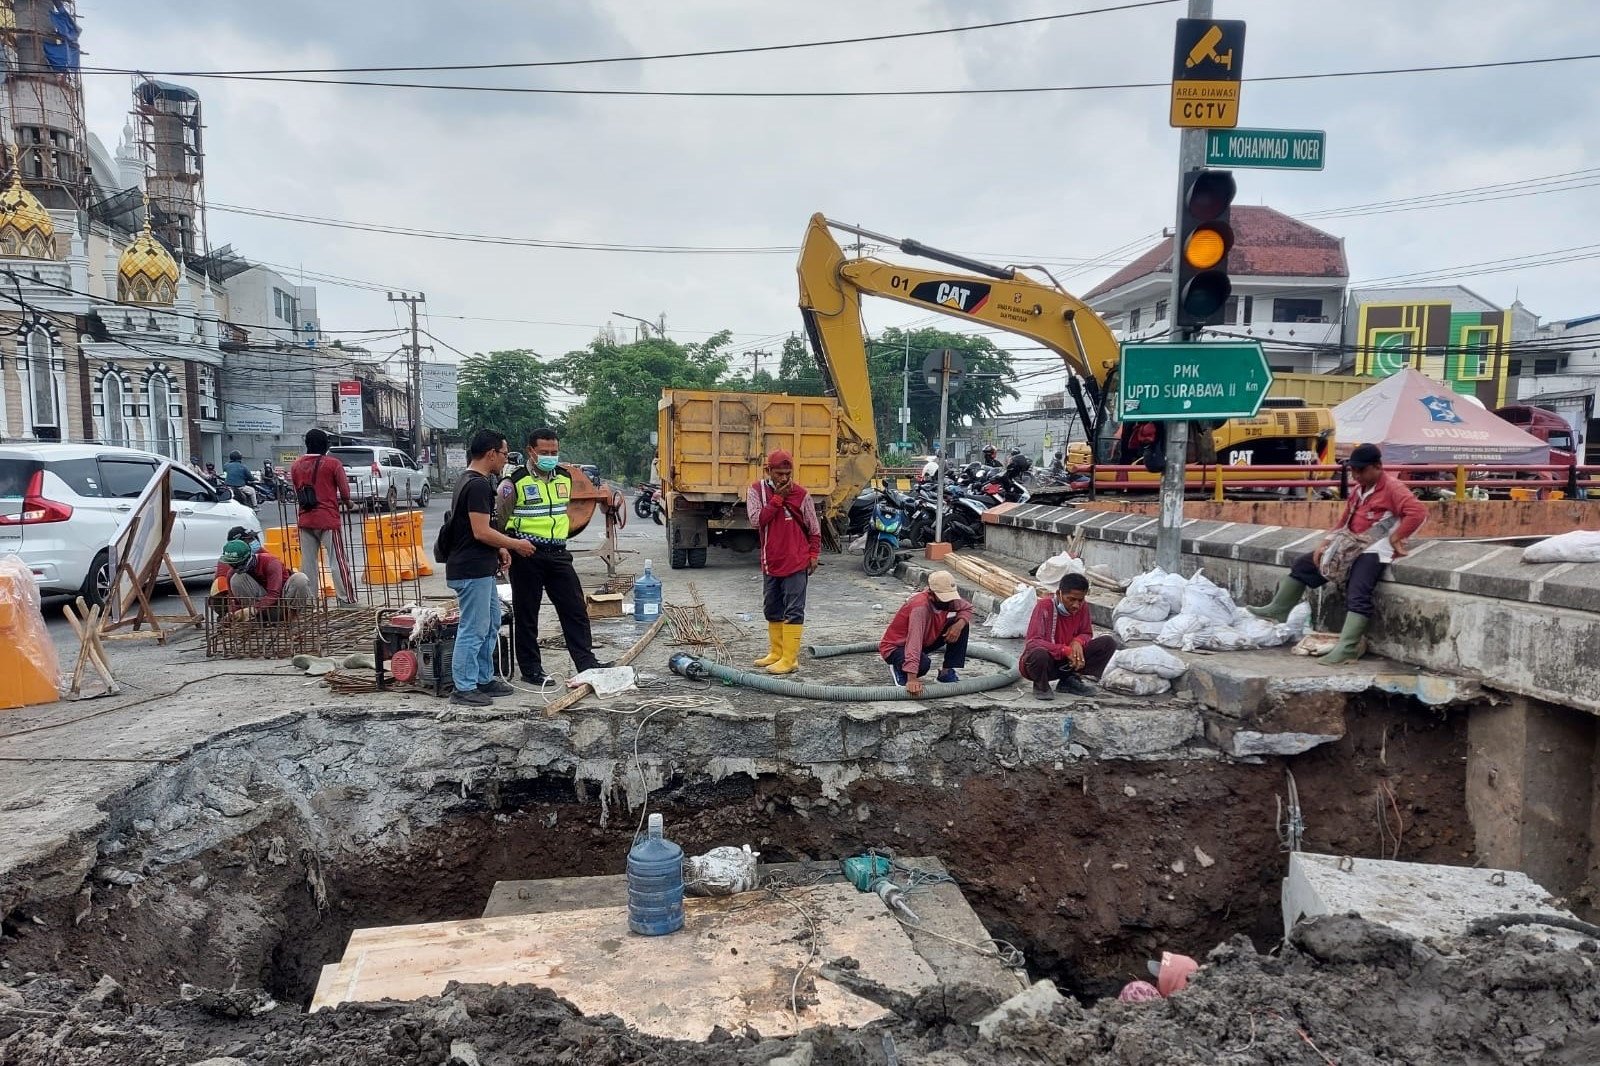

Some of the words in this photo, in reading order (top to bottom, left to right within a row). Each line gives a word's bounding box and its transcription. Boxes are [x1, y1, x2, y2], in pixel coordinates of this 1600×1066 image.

[1176, 87, 1198, 96] AREA
[1201, 88, 1236, 97] DIAWASI
[1183, 102, 1226, 119] CCTV
[1210, 136, 1224, 158] JL.
[1228, 136, 1289, 160] MOHAMMAD
[1292, 139, 1320, 160] NOER
[890, 275, 909, 291] 01
[936, 282, 971, 310] CAT
[1173, 364, 1199, 378] PMK
[1250, 369, 1254, 378] 1
[1127, 384, 1160, 398] UPTD
[1164, 383, 1224, 398] SURABAYA
[1245, 382, 1258, 391] Km
[1229, 450, 1254, 465] CAT
